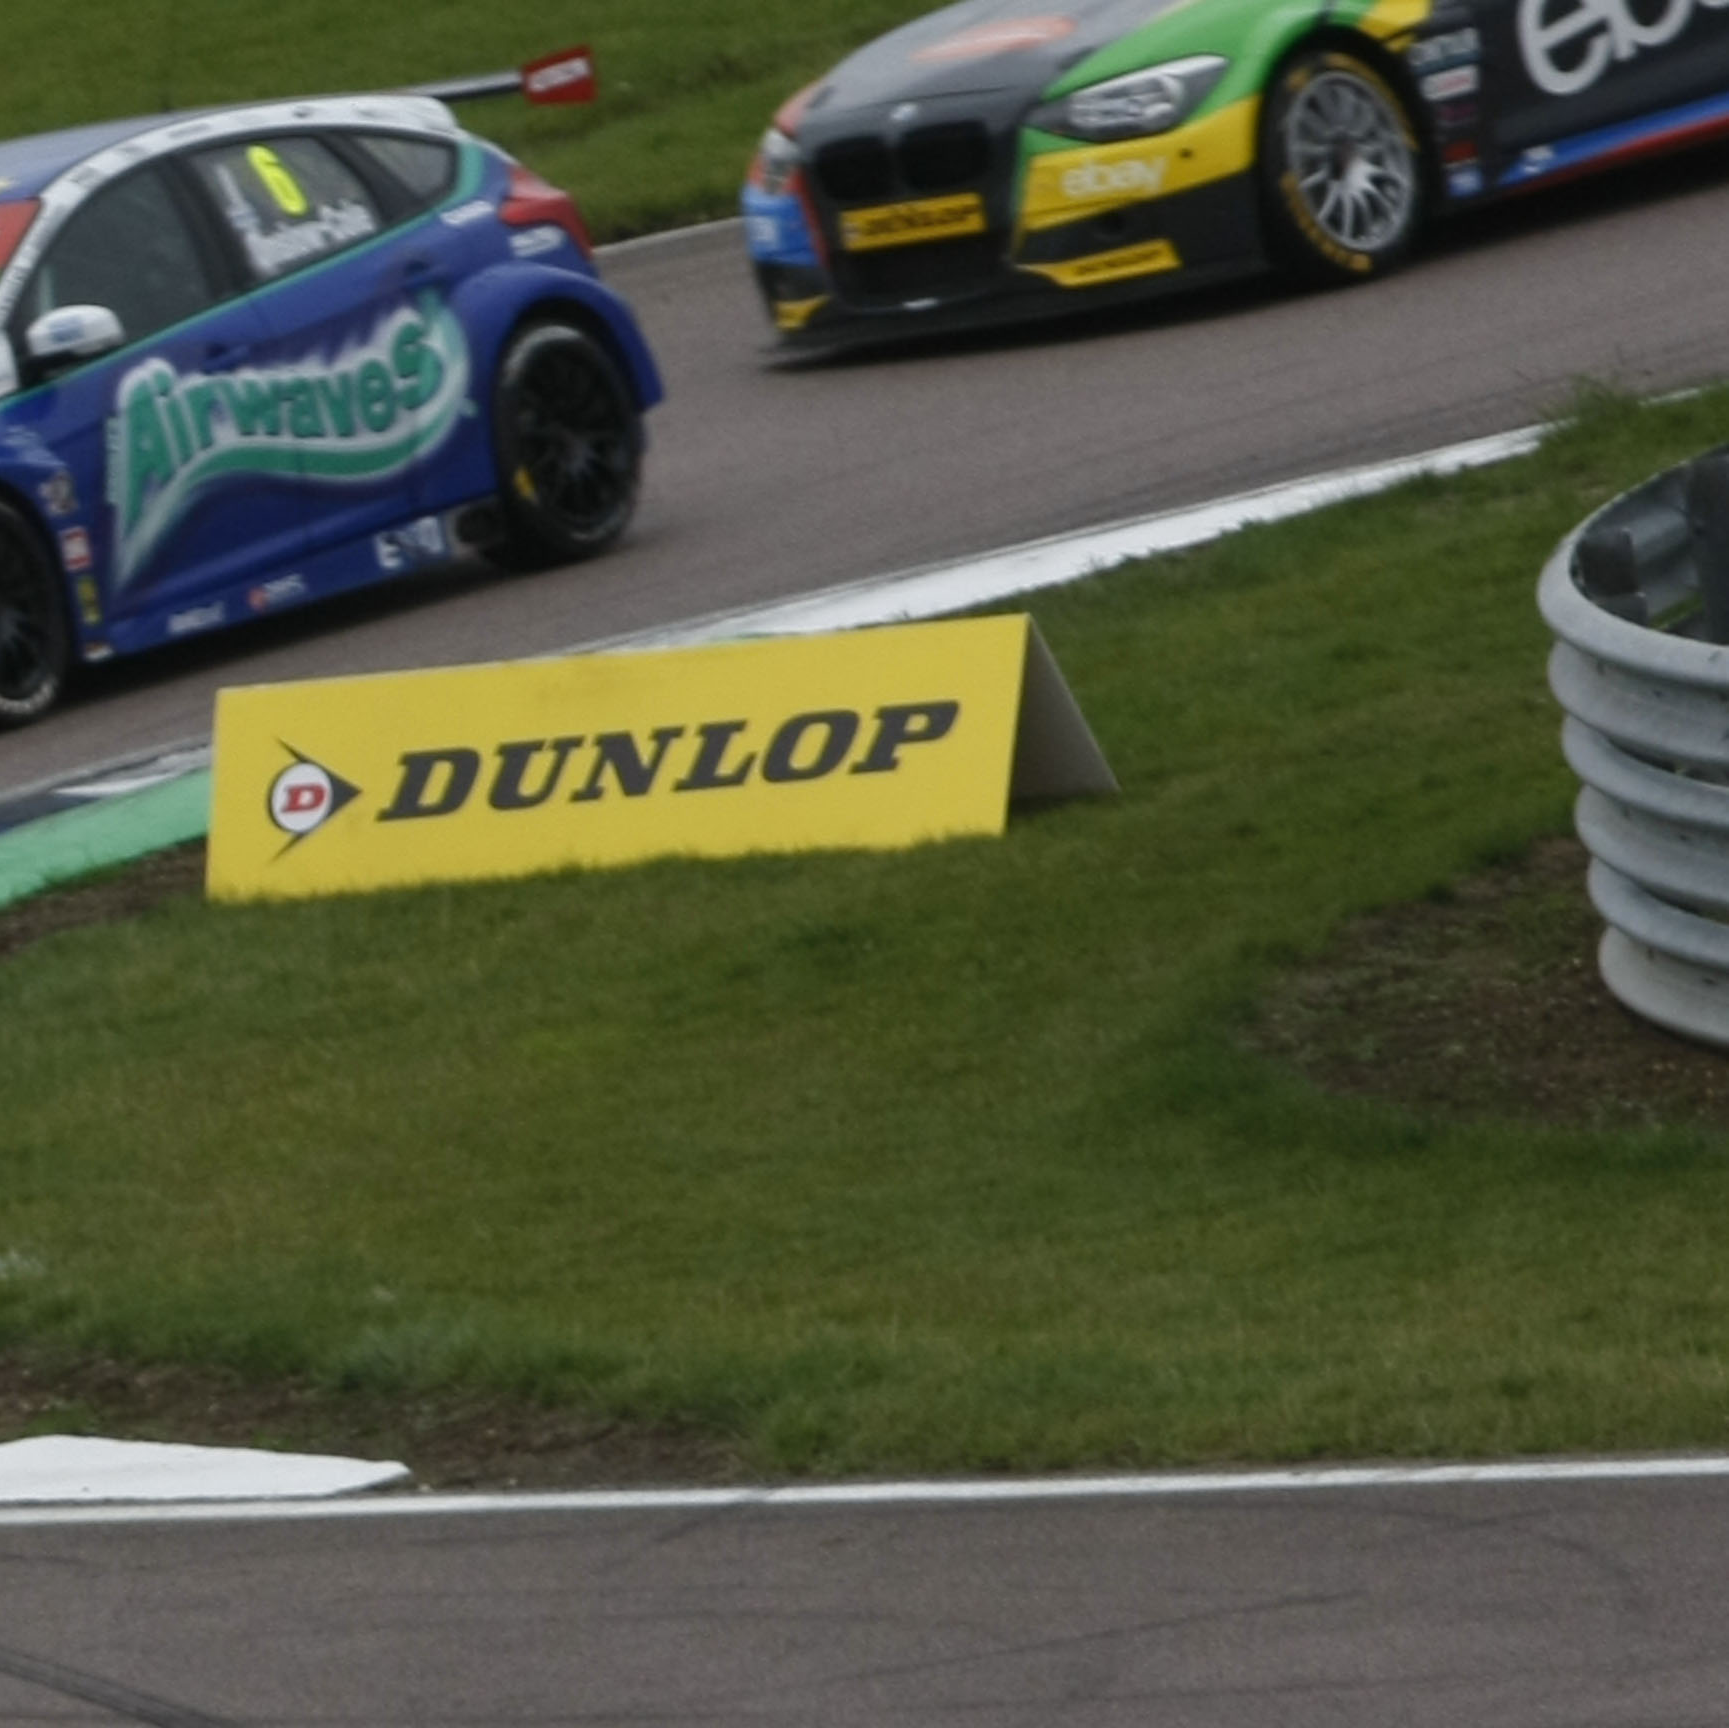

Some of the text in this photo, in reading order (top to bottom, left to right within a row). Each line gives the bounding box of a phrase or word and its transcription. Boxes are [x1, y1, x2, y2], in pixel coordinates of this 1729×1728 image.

[247, 146, 308, 216] 6
[1062, 156, 1168, 198] ebay
[117, 312, 444, 500] Airwaves
[377, 700, 960, 822] DUNLOP
